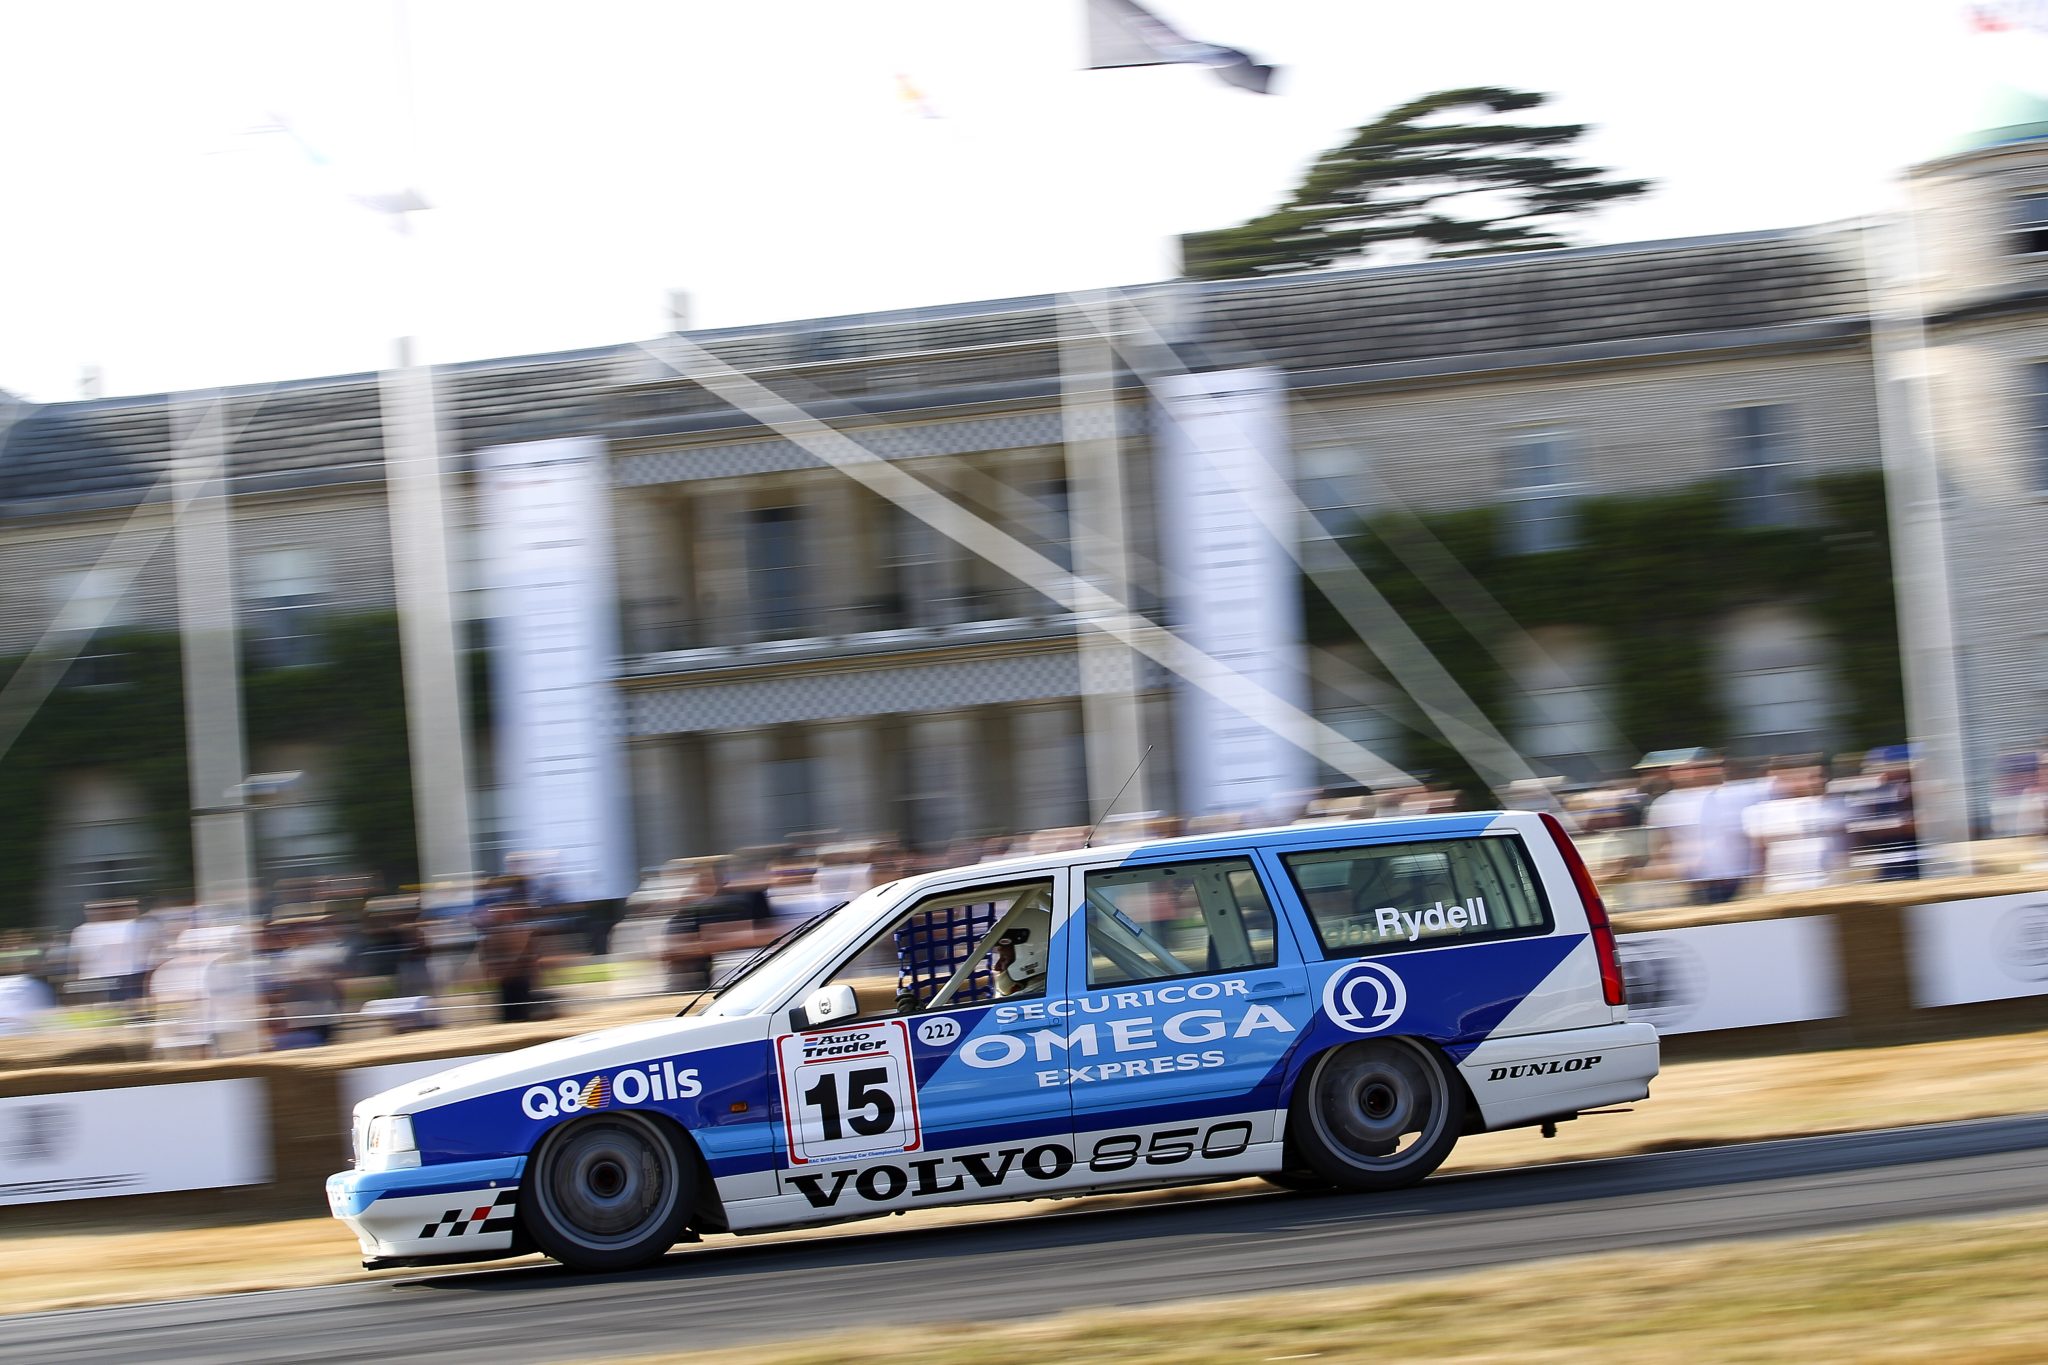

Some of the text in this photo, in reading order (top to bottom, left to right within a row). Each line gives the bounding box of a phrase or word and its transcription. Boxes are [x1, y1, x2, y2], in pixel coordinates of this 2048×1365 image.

[1375, 897, 1488, 942] Rydell
[995, 979, 1250, 1024] SECURICOR
[803, 1040, 887, 1058] Trader
[816, 1033, 870, 1046] Auto
[924, 1023, 955, 1040] 222
[959, 1005, 1296, 1069] OMEGA
[521, 1061, 703, 1120] Q8 Oils
[1035, 1050, 1225, 1088] EXPRESS
[1488, 1055, 1602, 1082] DUNLOP
[804, 1067, 896, 1141] 15
[785, 1120, 1253, 1208] VOLVO 850
